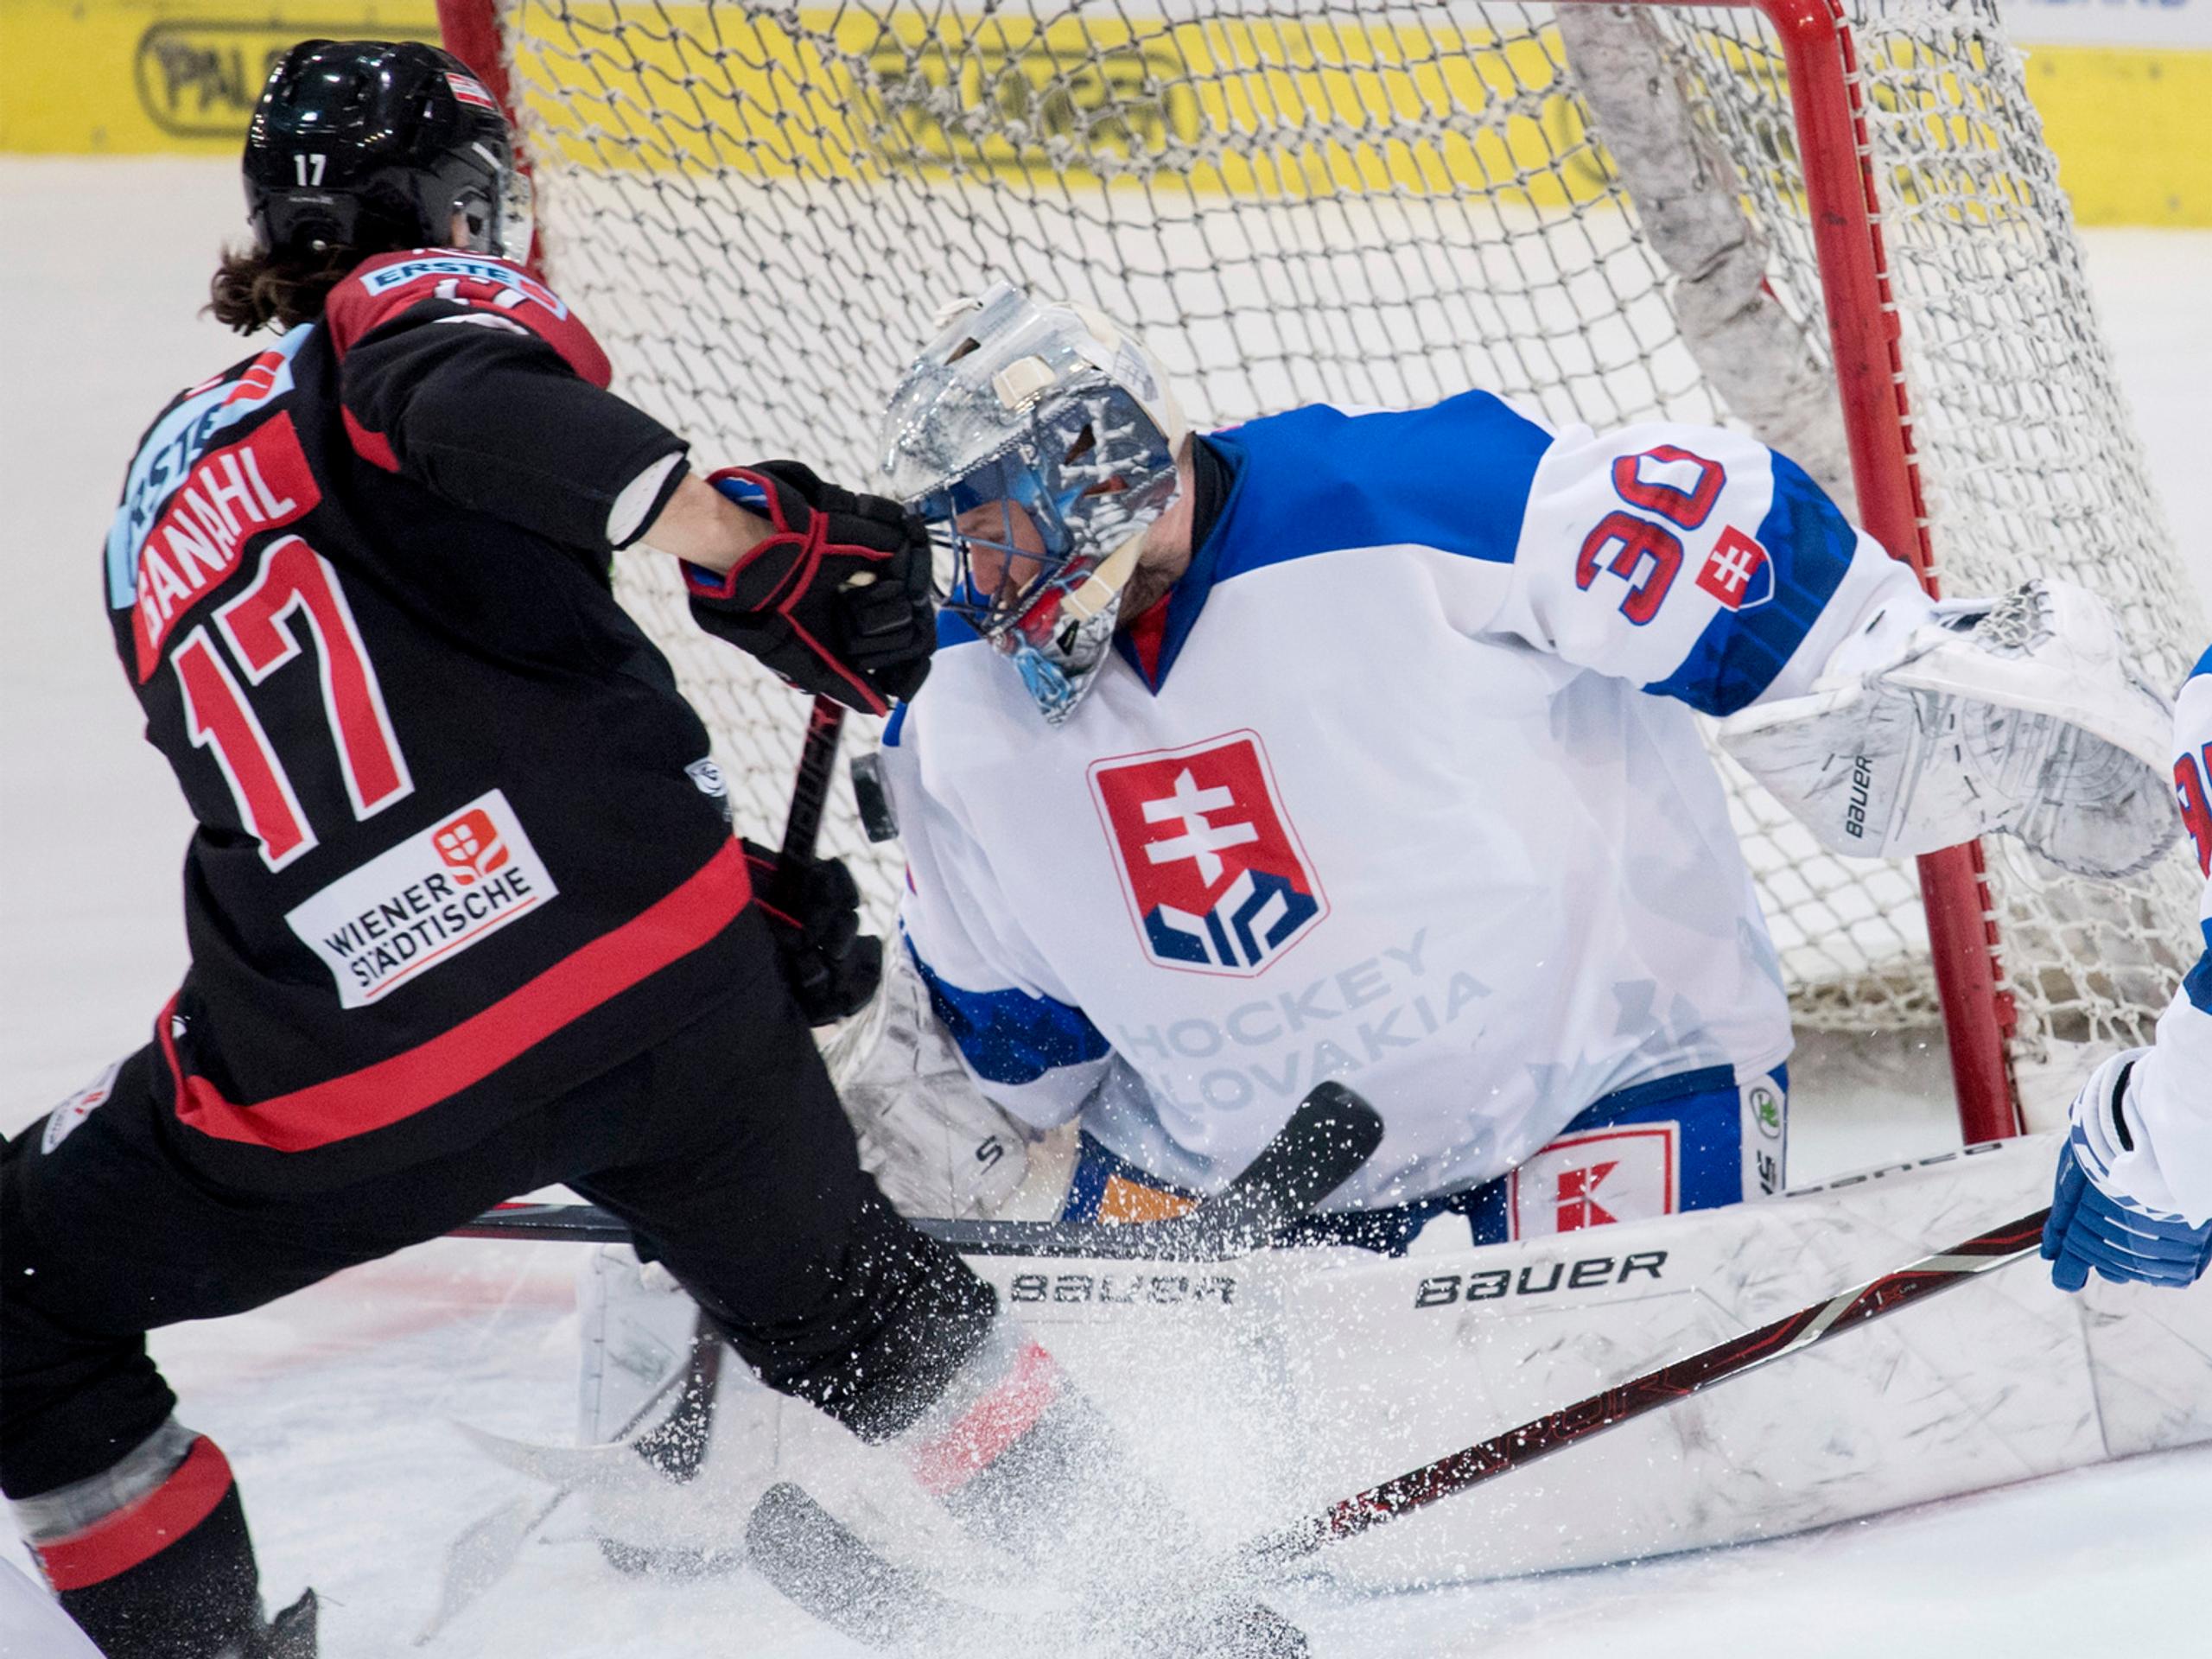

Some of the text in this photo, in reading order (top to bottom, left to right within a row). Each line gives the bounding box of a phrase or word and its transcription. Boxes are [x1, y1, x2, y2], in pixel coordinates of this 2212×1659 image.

[294, 153, 327, 187] 17
[374, 261, 513, 288] ERSTE
[1576, 444, 1727, 626] 30
[169, 534, 416, 874] 17
[323, 872, 454, 958] WIENER
[350, 866, 532, 988] STÄDTISCHE
[1116, 926, 1428, 1061] HOCKEY
[1156, 969, 1494, 1114] LOVAKIA
